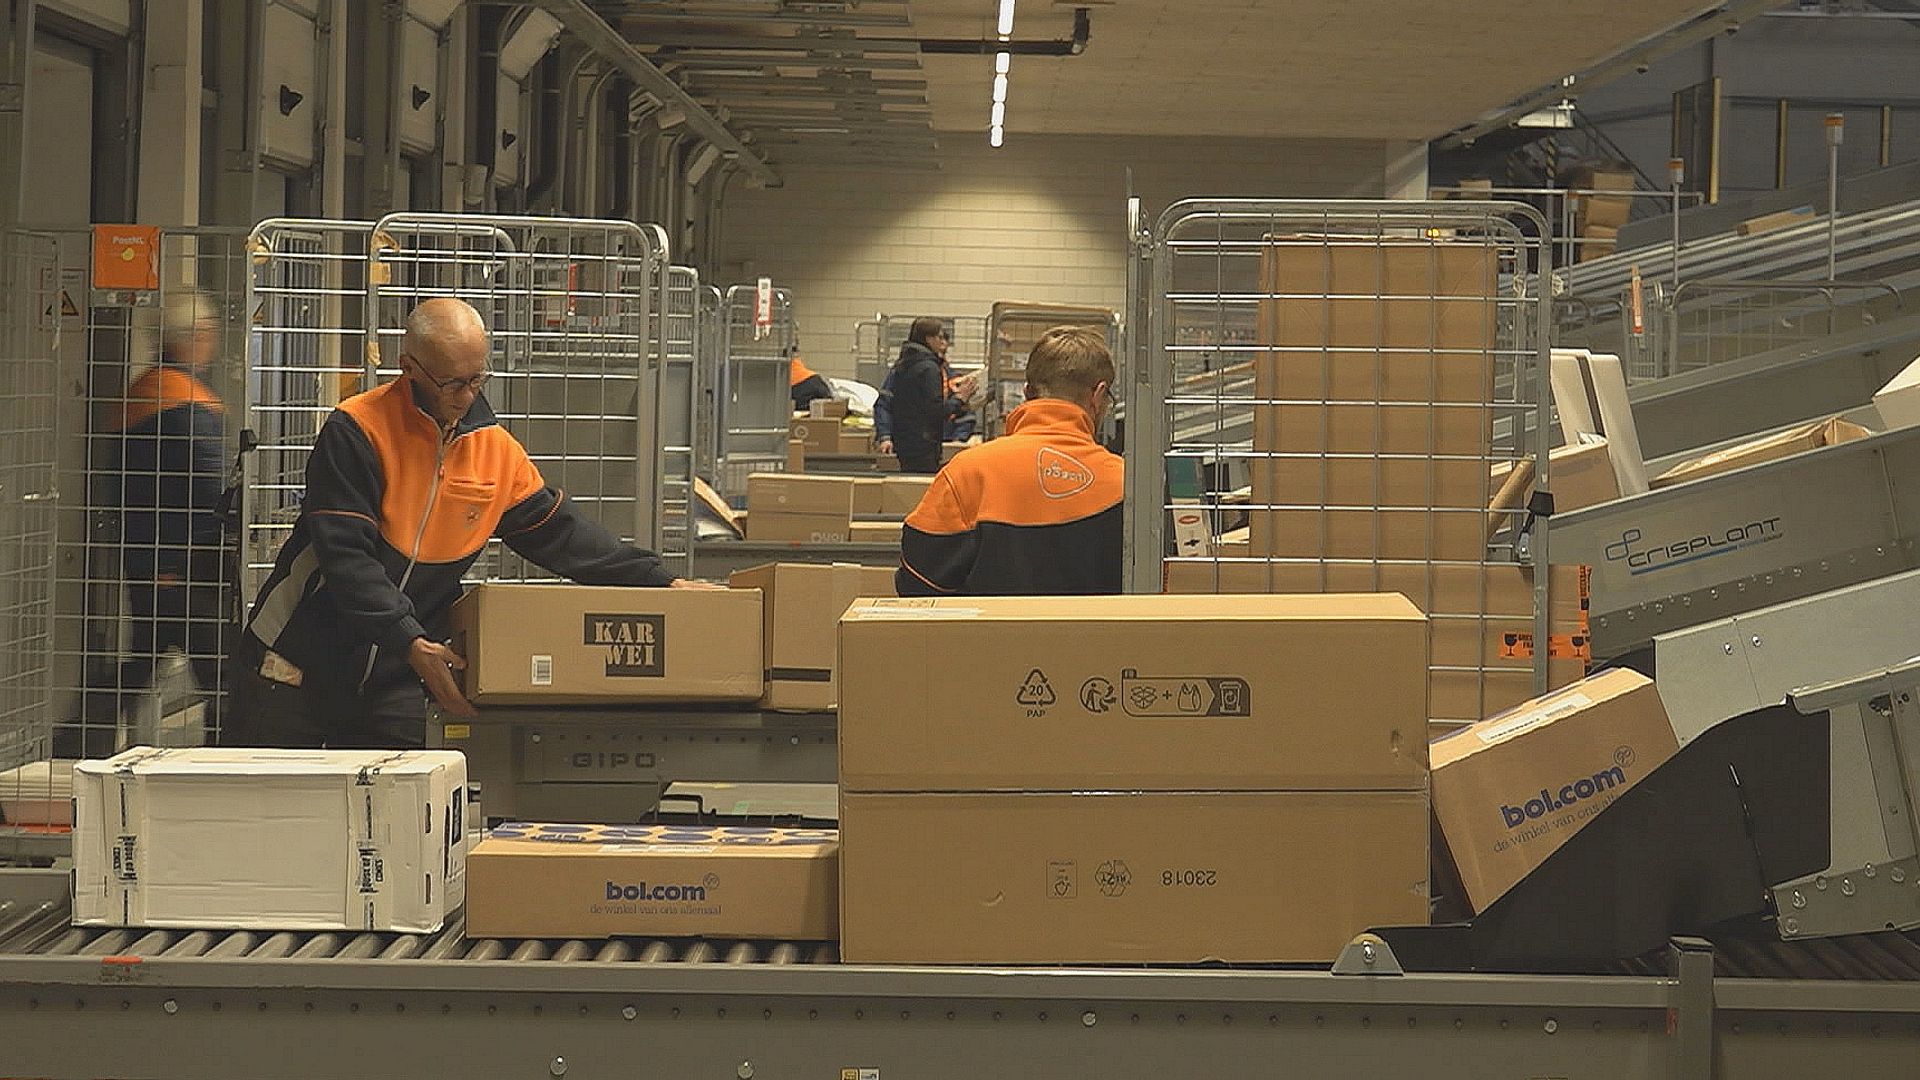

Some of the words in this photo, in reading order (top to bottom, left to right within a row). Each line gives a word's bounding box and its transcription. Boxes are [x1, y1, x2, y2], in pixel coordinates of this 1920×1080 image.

[594, 621, 656, 644] KAR
[606, 645, 655, 666] WEI
[1029, 684, 1044, 697] 20
[1026, 709, 1046, 718] PAP
[572, 752, 656, 769] GIPO
[1500, 766, 1626, 829] bol.com
[1493, 840, 1509, 853] de
[1510, 821, 1551, 847] winkel
[1552, 812, 1576, 829] van
[1161, 870, 1217, 886] 23018
[606, 881, 706, 901] bol.com
[590, 903, 603, 914] de
[605, 903, 637, 915] winkel
[640, 905, 658, 915] van
